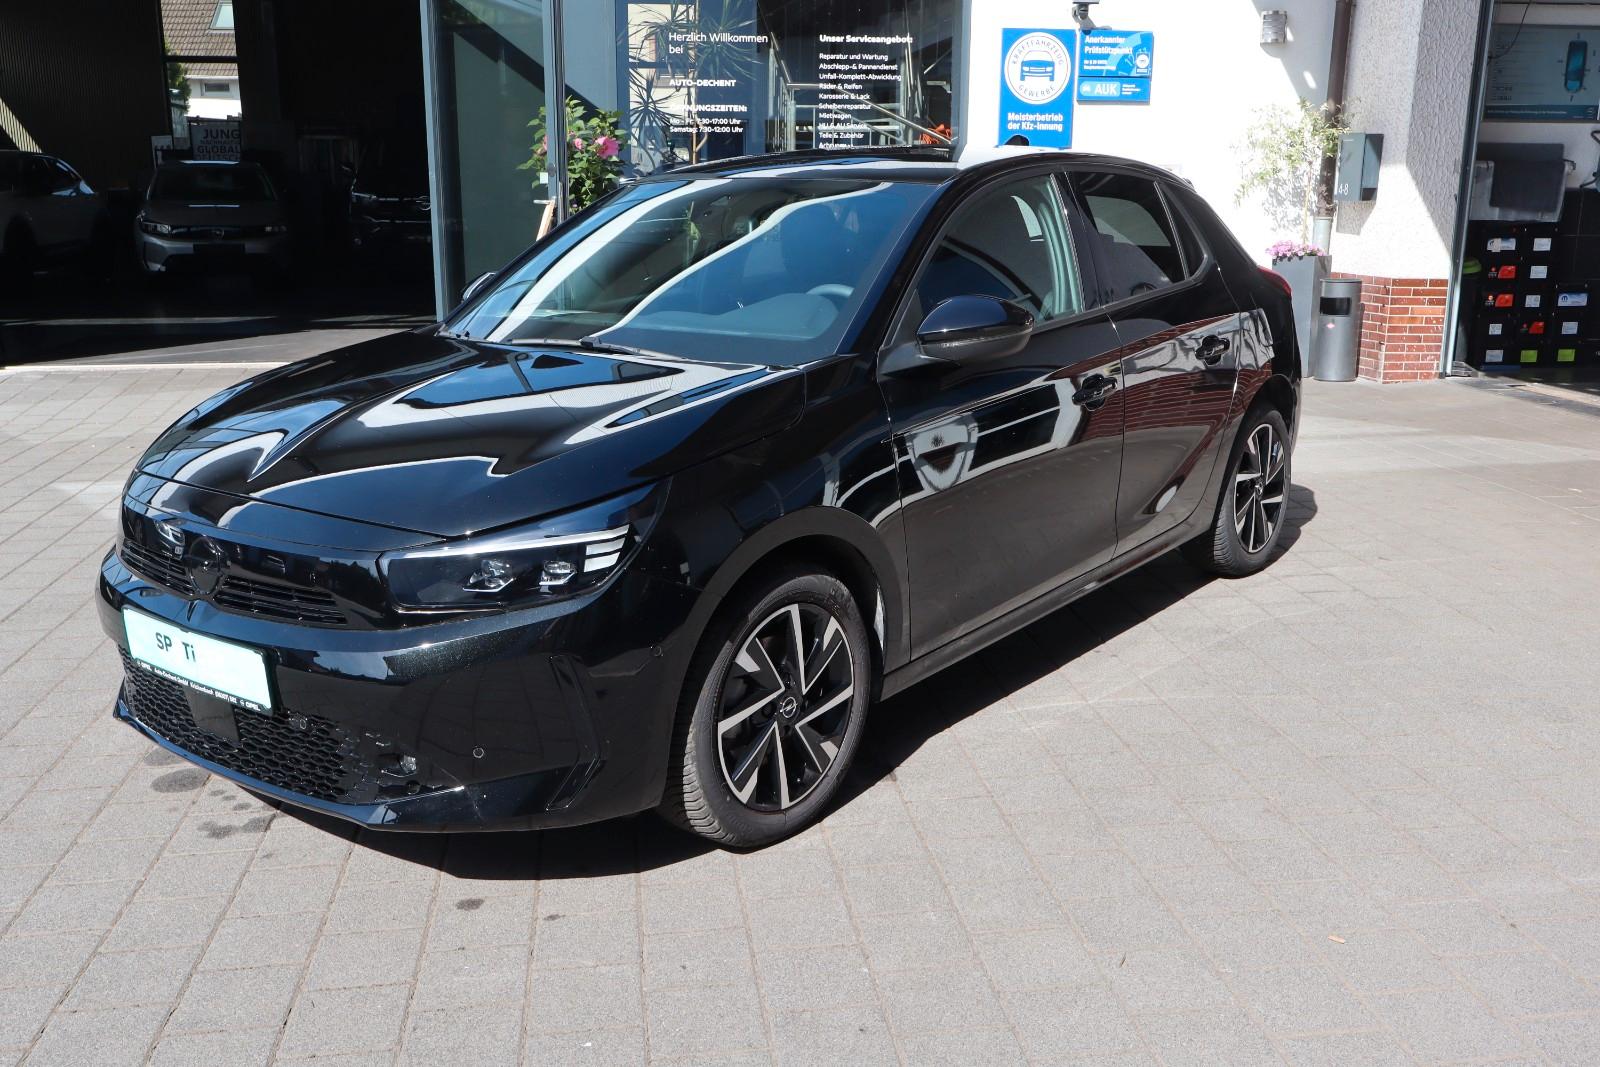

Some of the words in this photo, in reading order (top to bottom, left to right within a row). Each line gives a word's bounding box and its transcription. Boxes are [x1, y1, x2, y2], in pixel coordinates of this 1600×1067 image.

[669, 32, 707, 42] Herzlich
[709, 33, 768, 43] Willkommen
[819, 34, 844, 42] Unser
[846, 35, 913, 45] Serviceangebot:
[669, 44, 683, 54] bei
[862, 53, 889, 61] Wartung
[669, 79, 736, 87] AUTO-DECHENT
[1094, 84, 1117, 95] AUK
[1008, 112, 1063, 122] Meisterbetrieb
[1008, 121, 1020, 130] der
[1021, 121, 1063, 131] Kfz-Innung
[203, 129, 240, 139] JUNG
[197, 145, 240, 153] GLOBAL
[155, 631, 173, 652] SP
[182, 641, 196, 662] Ti
